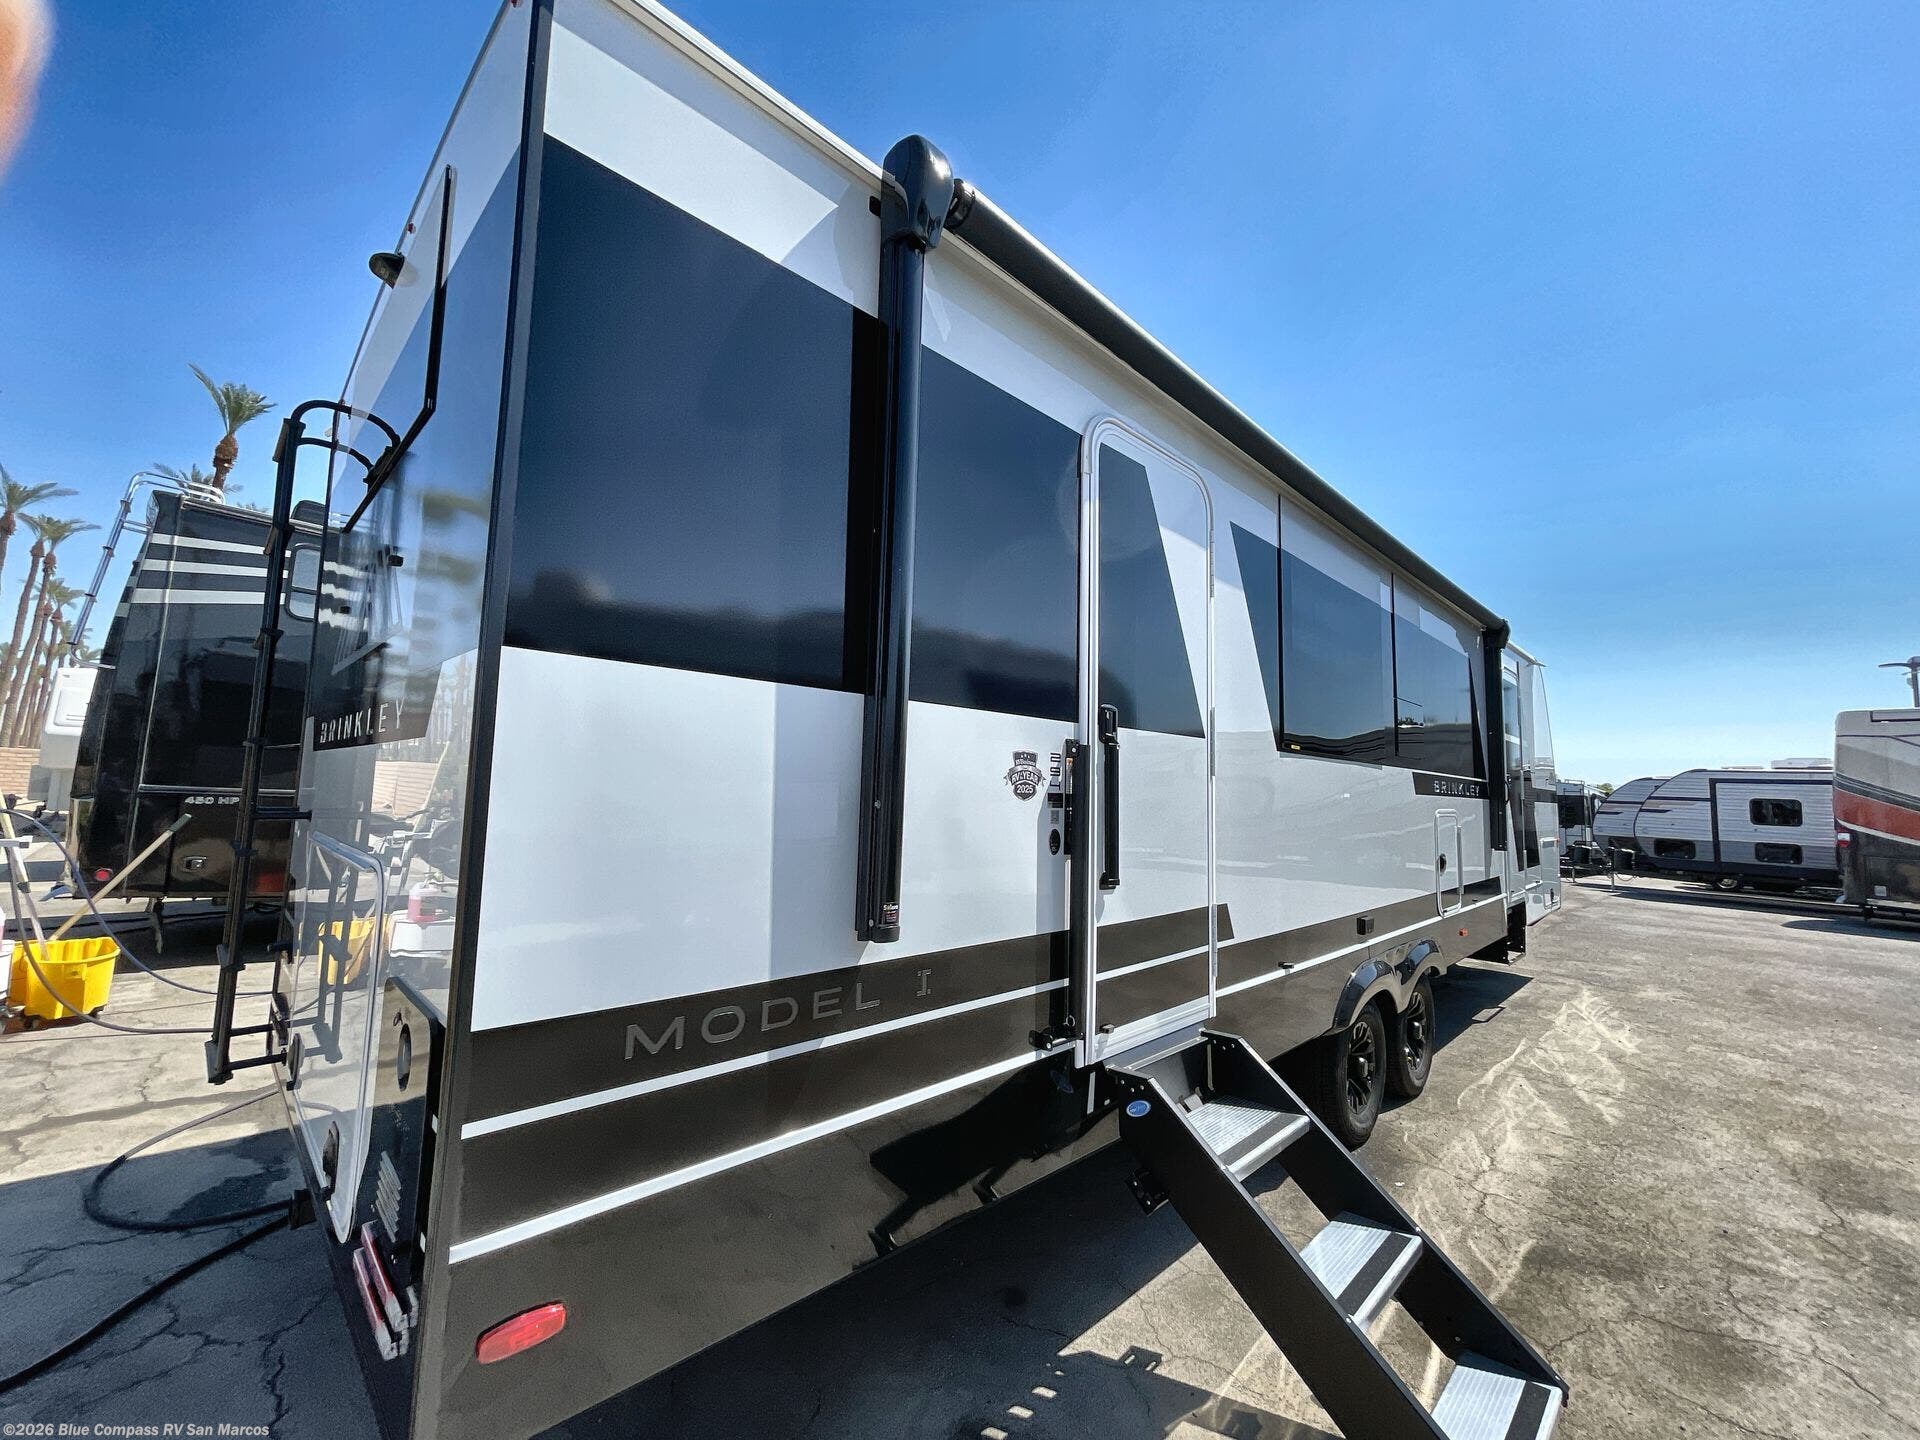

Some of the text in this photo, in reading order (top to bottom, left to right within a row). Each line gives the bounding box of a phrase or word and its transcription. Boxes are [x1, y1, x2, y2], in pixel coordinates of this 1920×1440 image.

[320, 697, 405, 743] BRINKLEY
[1016, 784, 1034, 794] 2025
[1433, 780, 1480, 797] BRINKLEY
[217, 796, 240, 805] HP
[624, 968, 932, 1060] MODEL I
